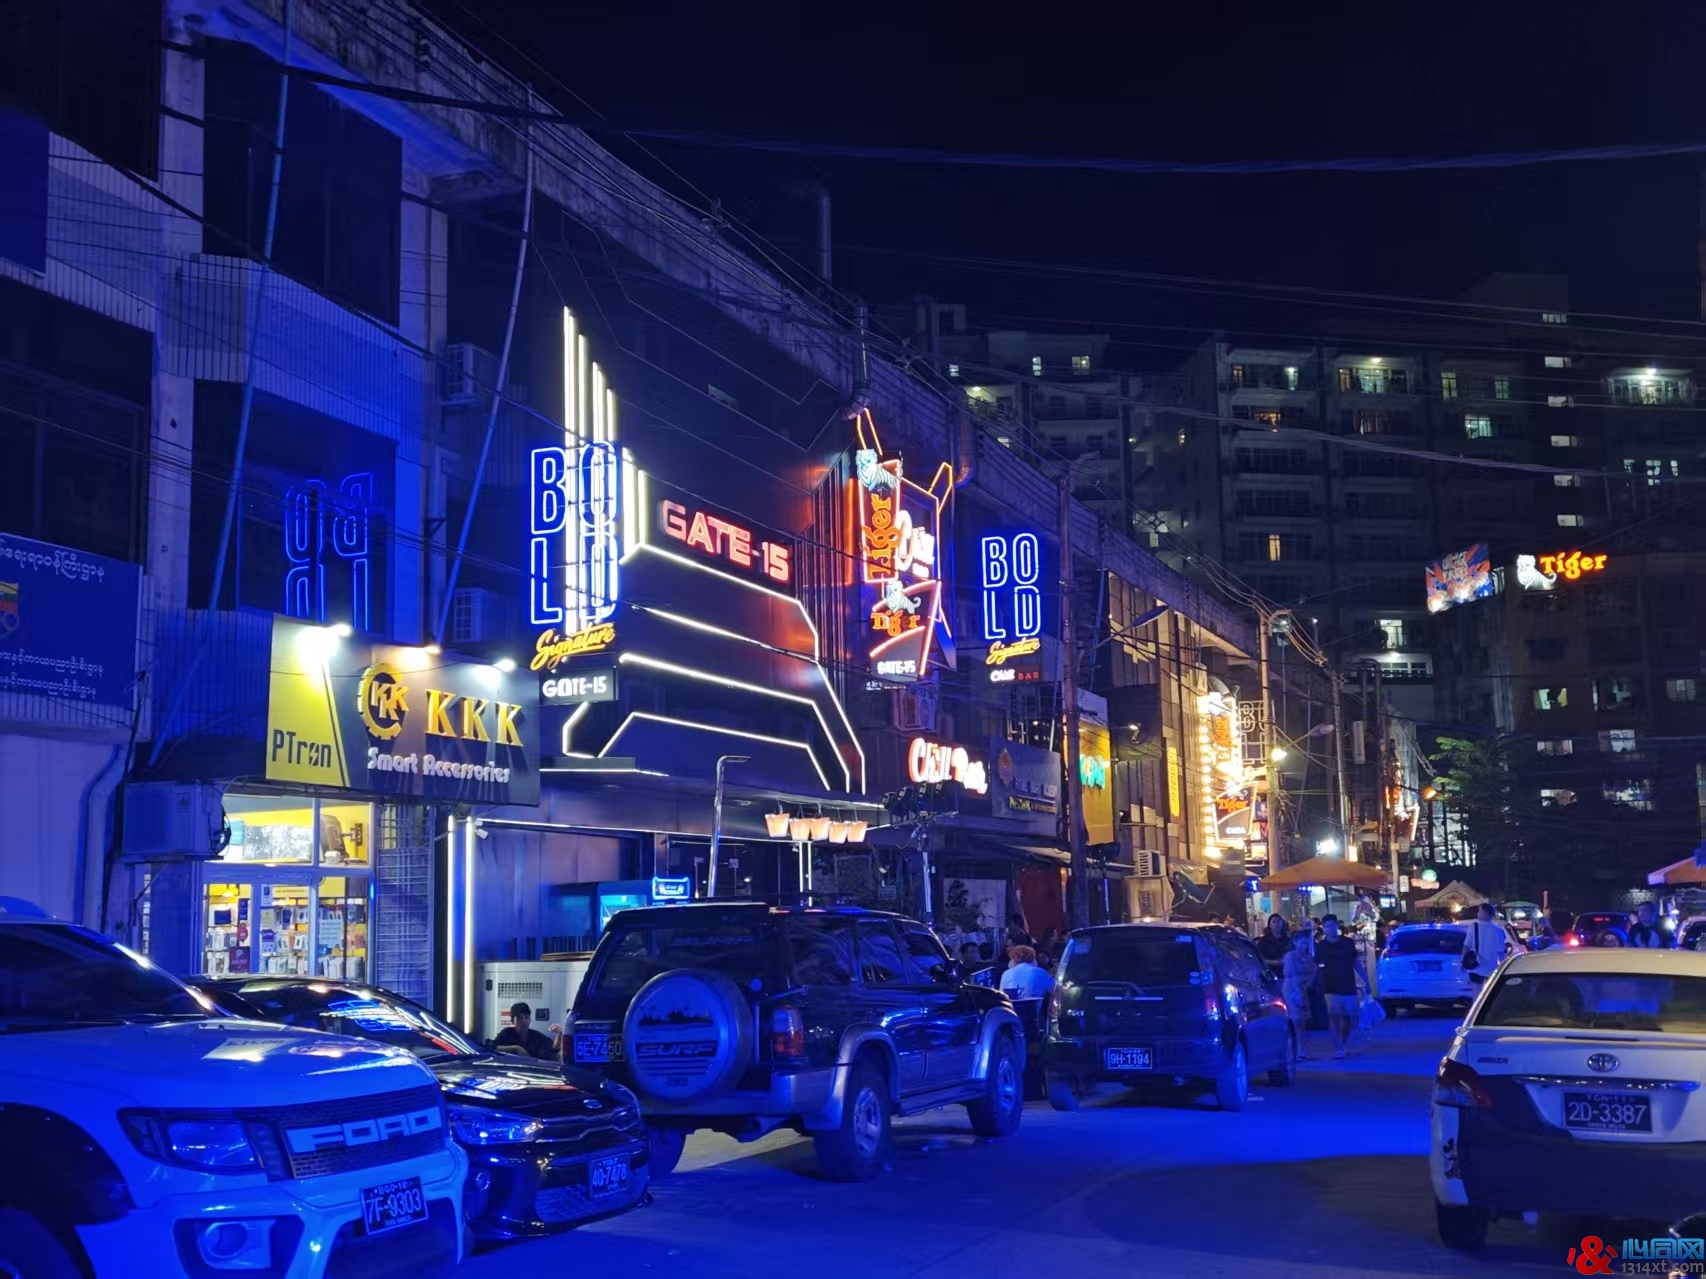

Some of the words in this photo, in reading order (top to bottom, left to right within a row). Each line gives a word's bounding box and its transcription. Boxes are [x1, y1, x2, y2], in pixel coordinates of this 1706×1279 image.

[661, 499, 790, 582] GATE-15
[863, 493, 901, 579] Tiger
[1539, 551, 1607, 579] Tiger
[529, 622, 616, 670] Signature
[986, 637, 1041, 665] Signature
[541, 675, 607, 698] GATE-15
[425, 688, 524, 747] KKK
[271, 729, 332, 768] PTron
[367, 746, 418, 774] Smart
[423, 753, 511, 784] Accessories
[640, 1043, 717, 1056] SURF
[285, 1106, 442, 1154] FORD
[1568, 1101, 1648, 1125] 2D-3387
[366, 1188, 421, 1224] 7F-9303
